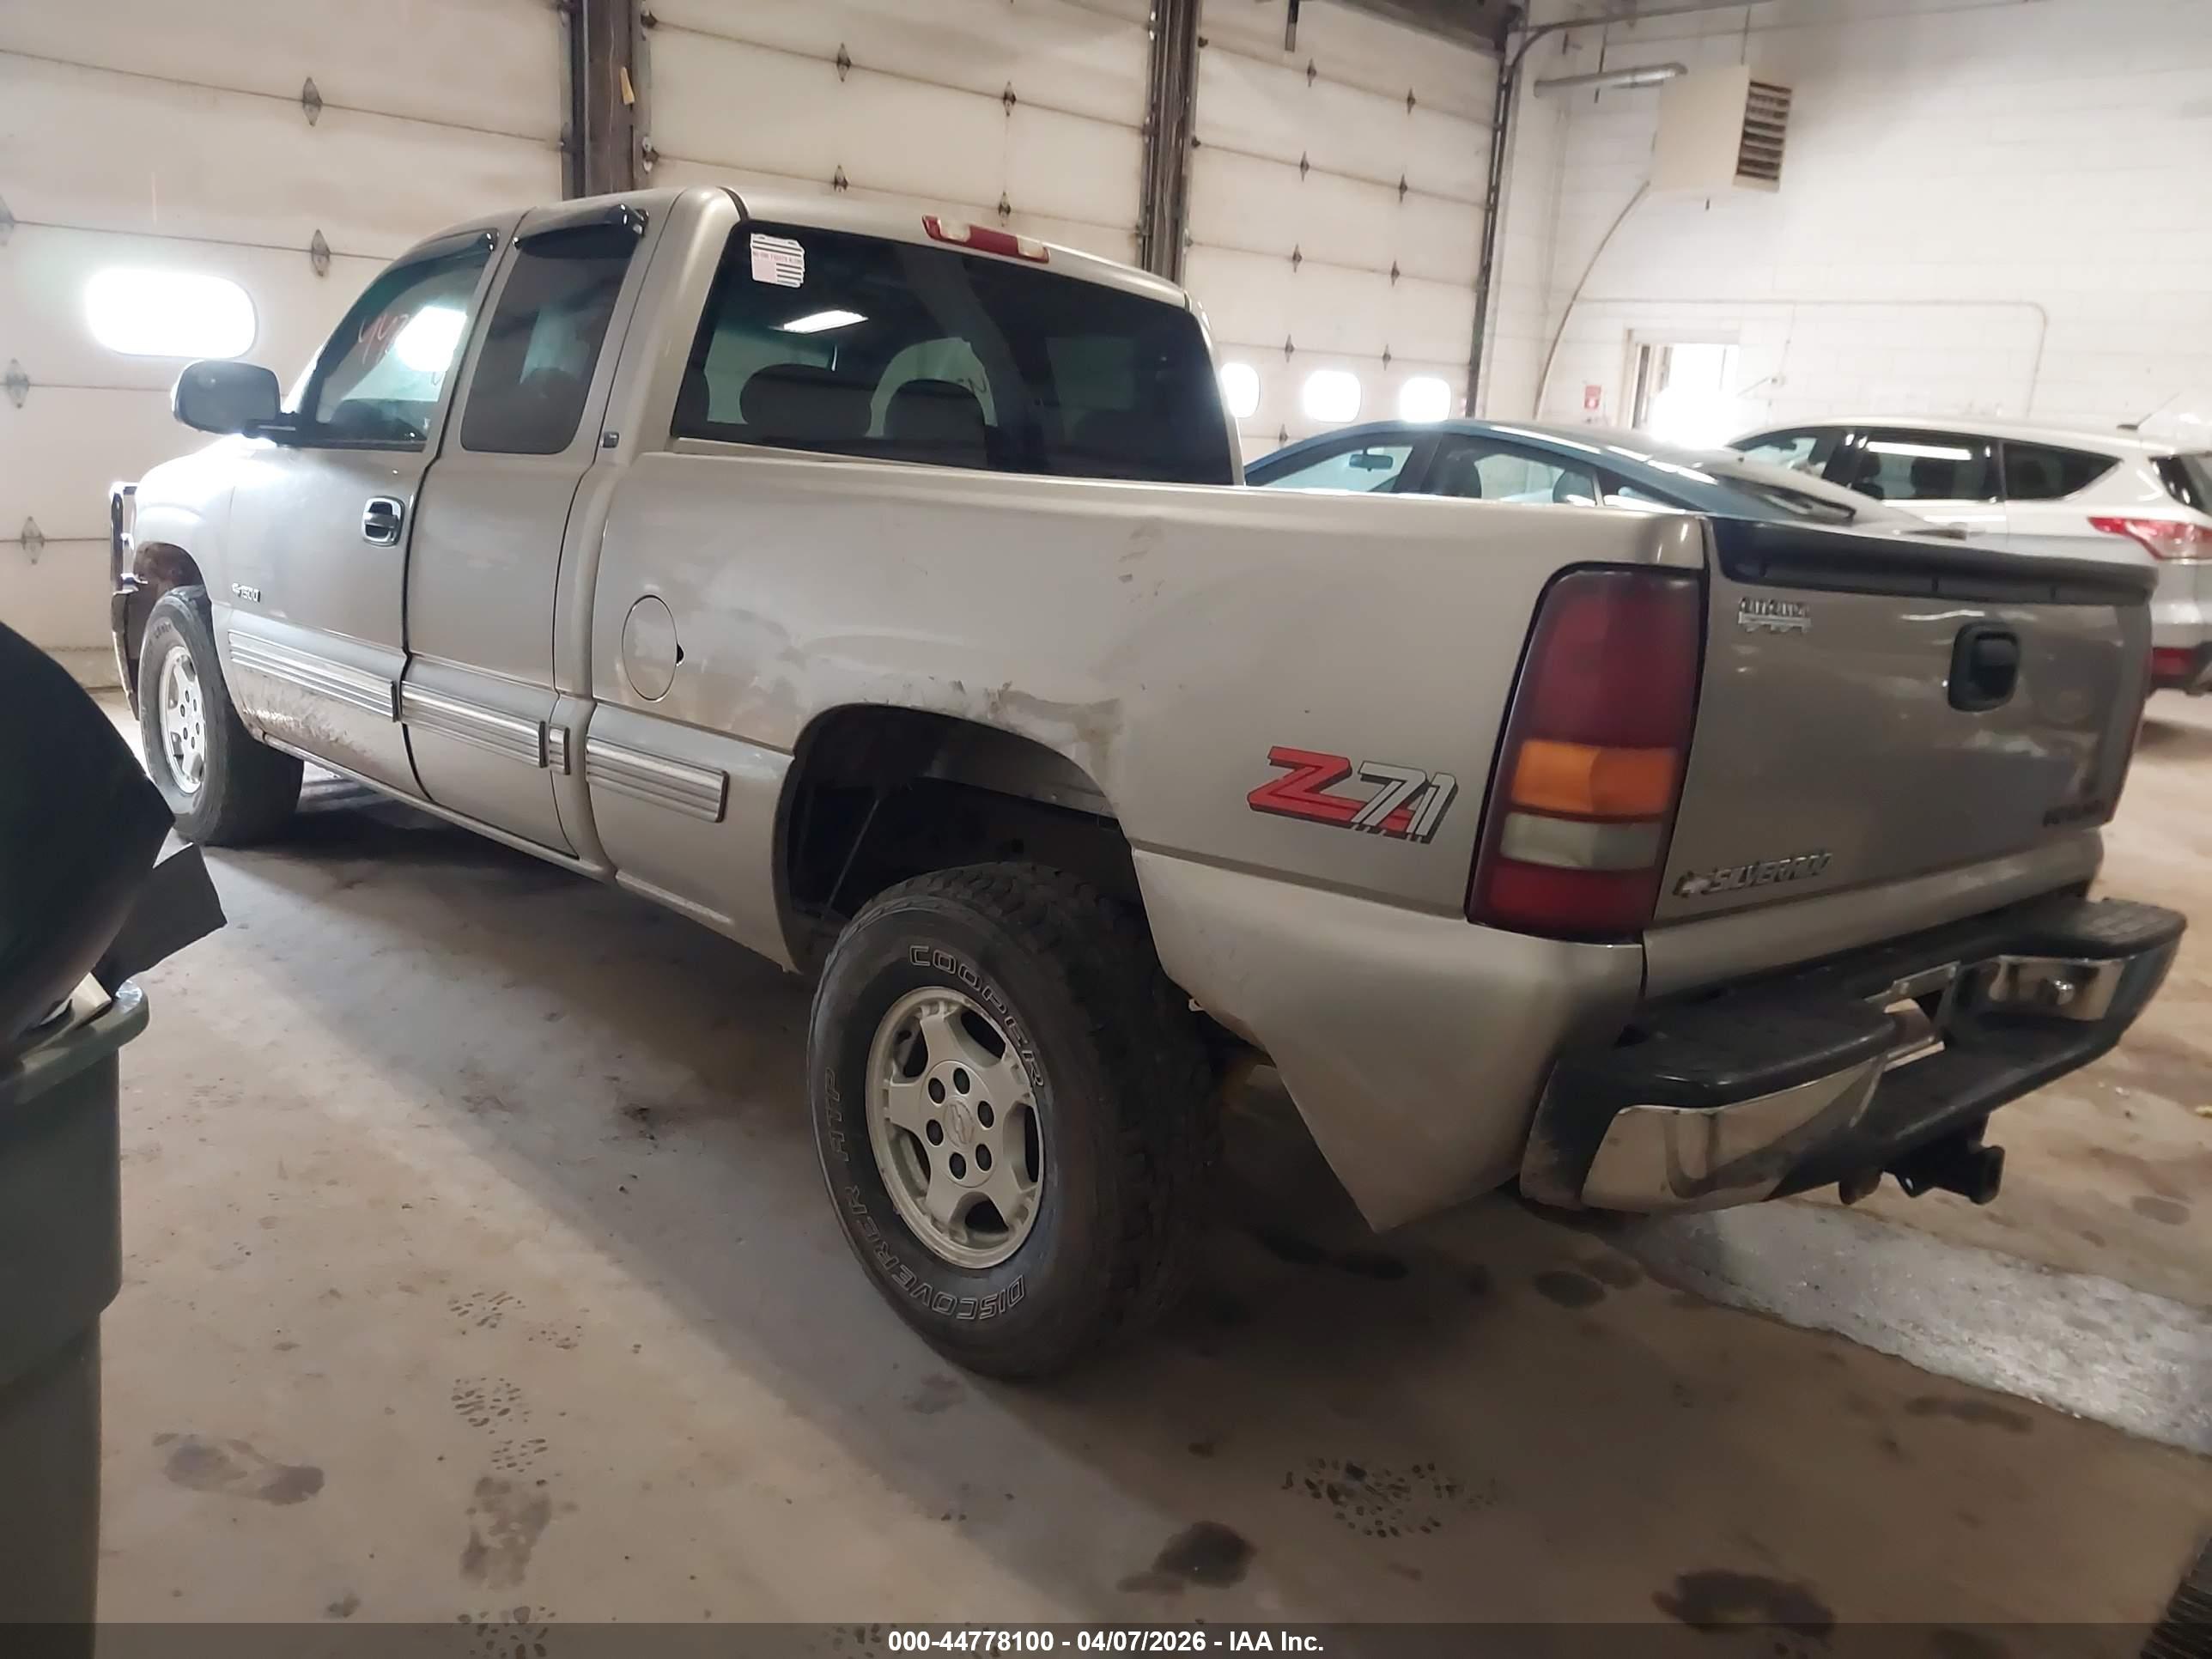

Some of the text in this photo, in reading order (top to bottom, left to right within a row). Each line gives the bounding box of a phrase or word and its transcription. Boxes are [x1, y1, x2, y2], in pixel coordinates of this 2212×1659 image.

[1246, 745, 1459, 845] Z71
[908, 945, 1044, 1088] COOPER
[844, 1184, 1028, 1321] DISCOVERER
